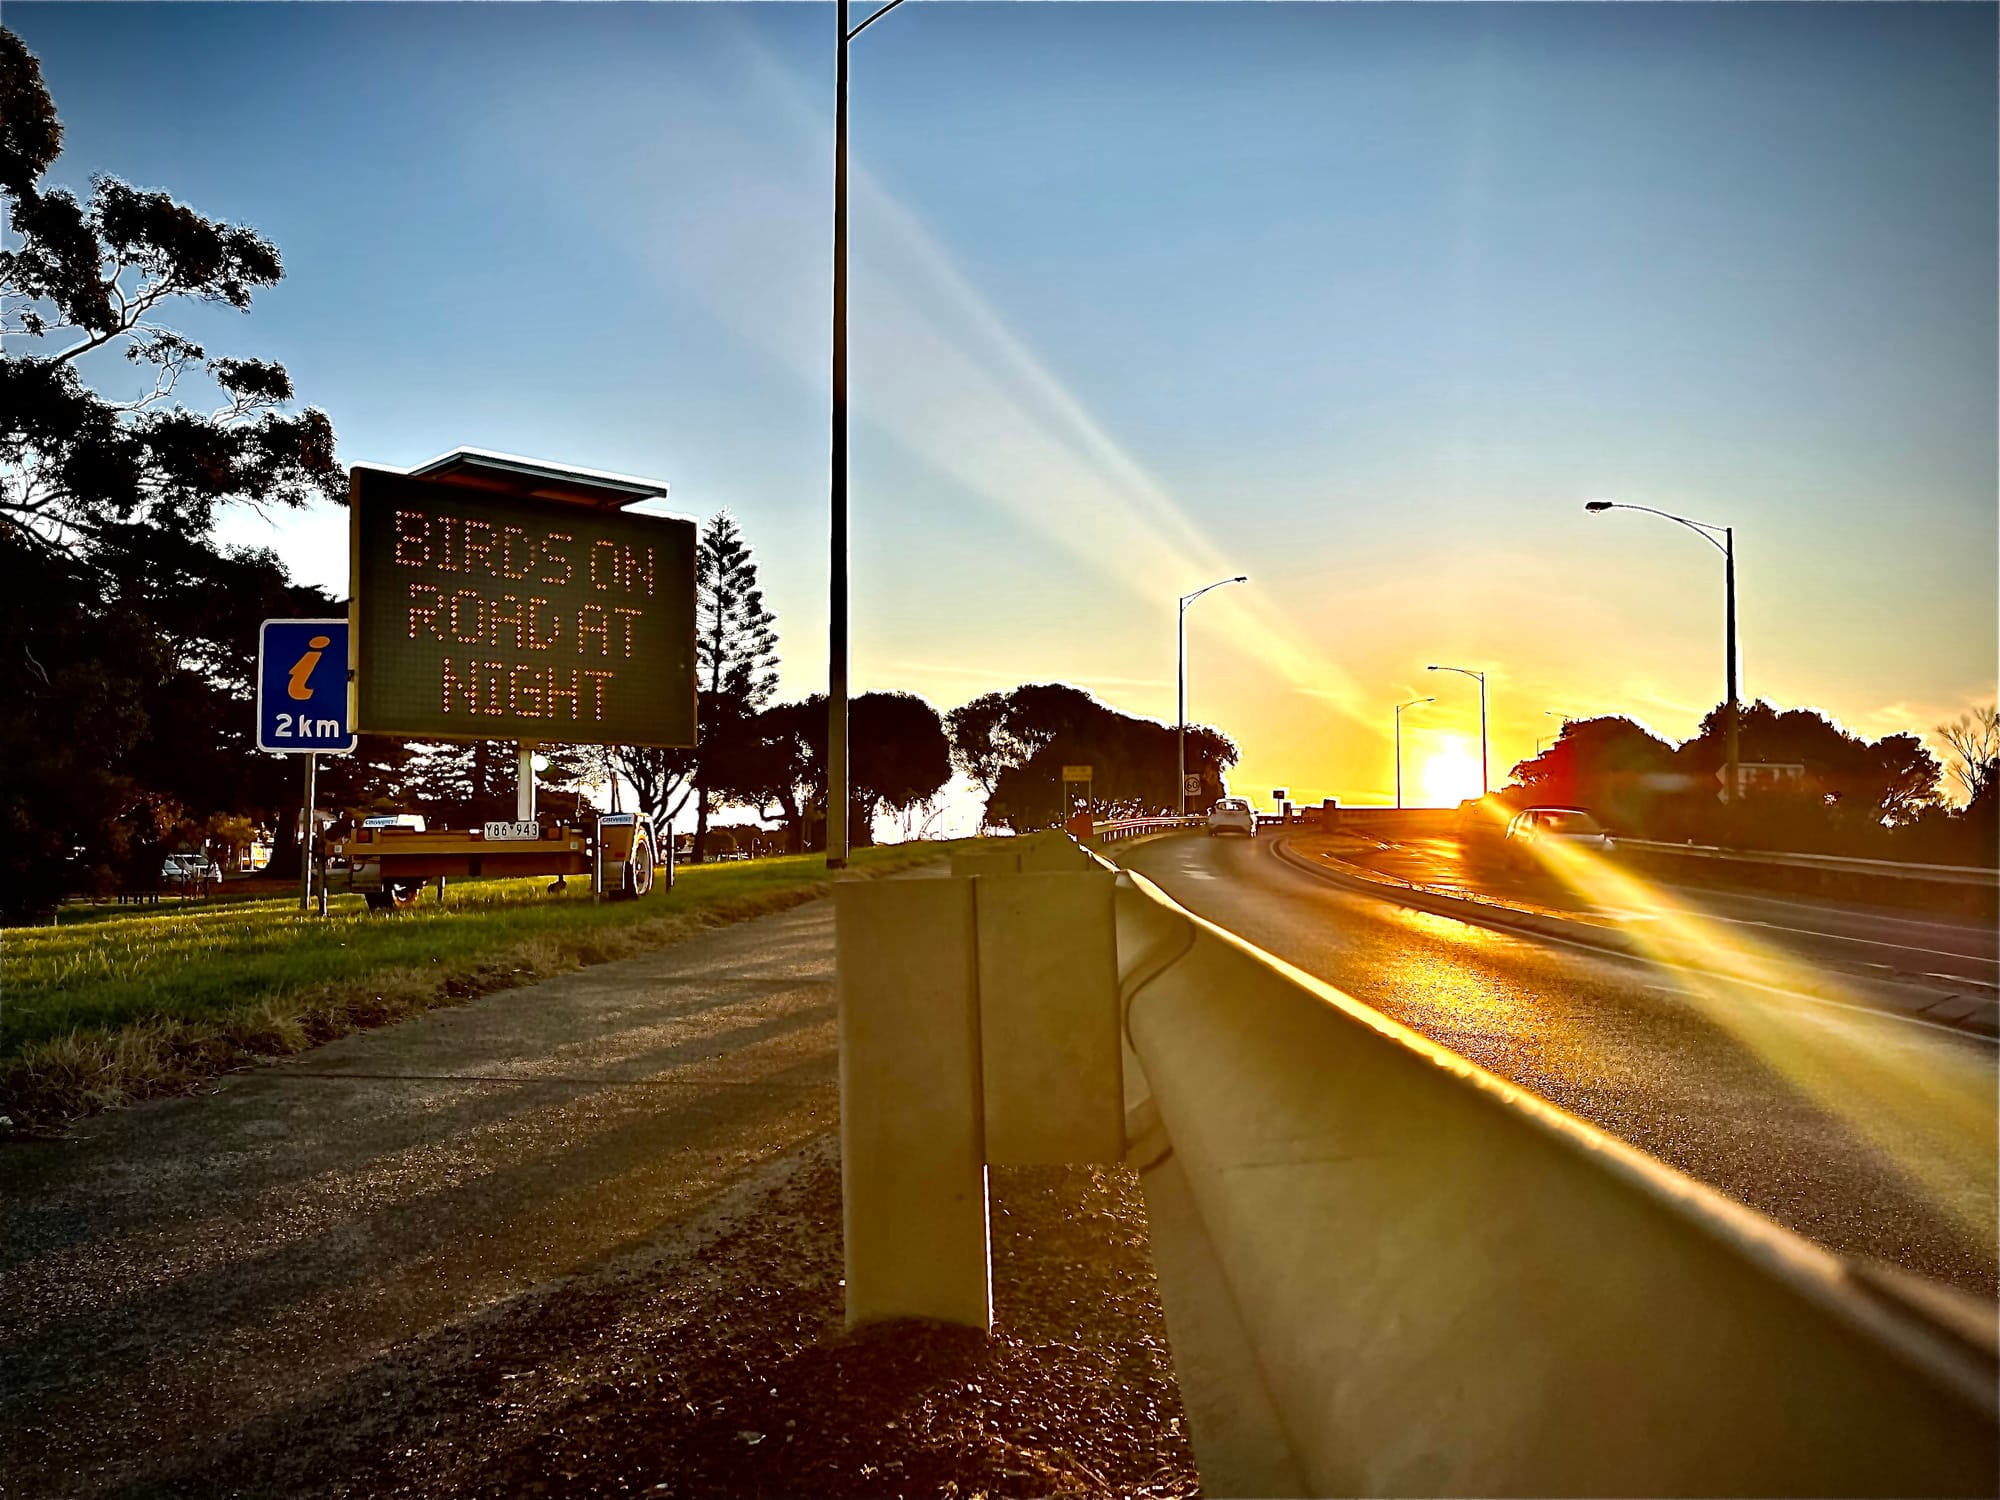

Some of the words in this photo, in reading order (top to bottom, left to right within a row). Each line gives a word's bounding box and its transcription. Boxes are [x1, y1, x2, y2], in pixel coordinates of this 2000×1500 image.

[395, 510, 572, 585] BIRDS
[590, 540, 654, 596] ON
[408, 583, 561, 650] ROAD
[577, 604, 643, 658] AT
[443, 657, 614, 721] NIGHT
[1187, 780, 1198, 789] 60
